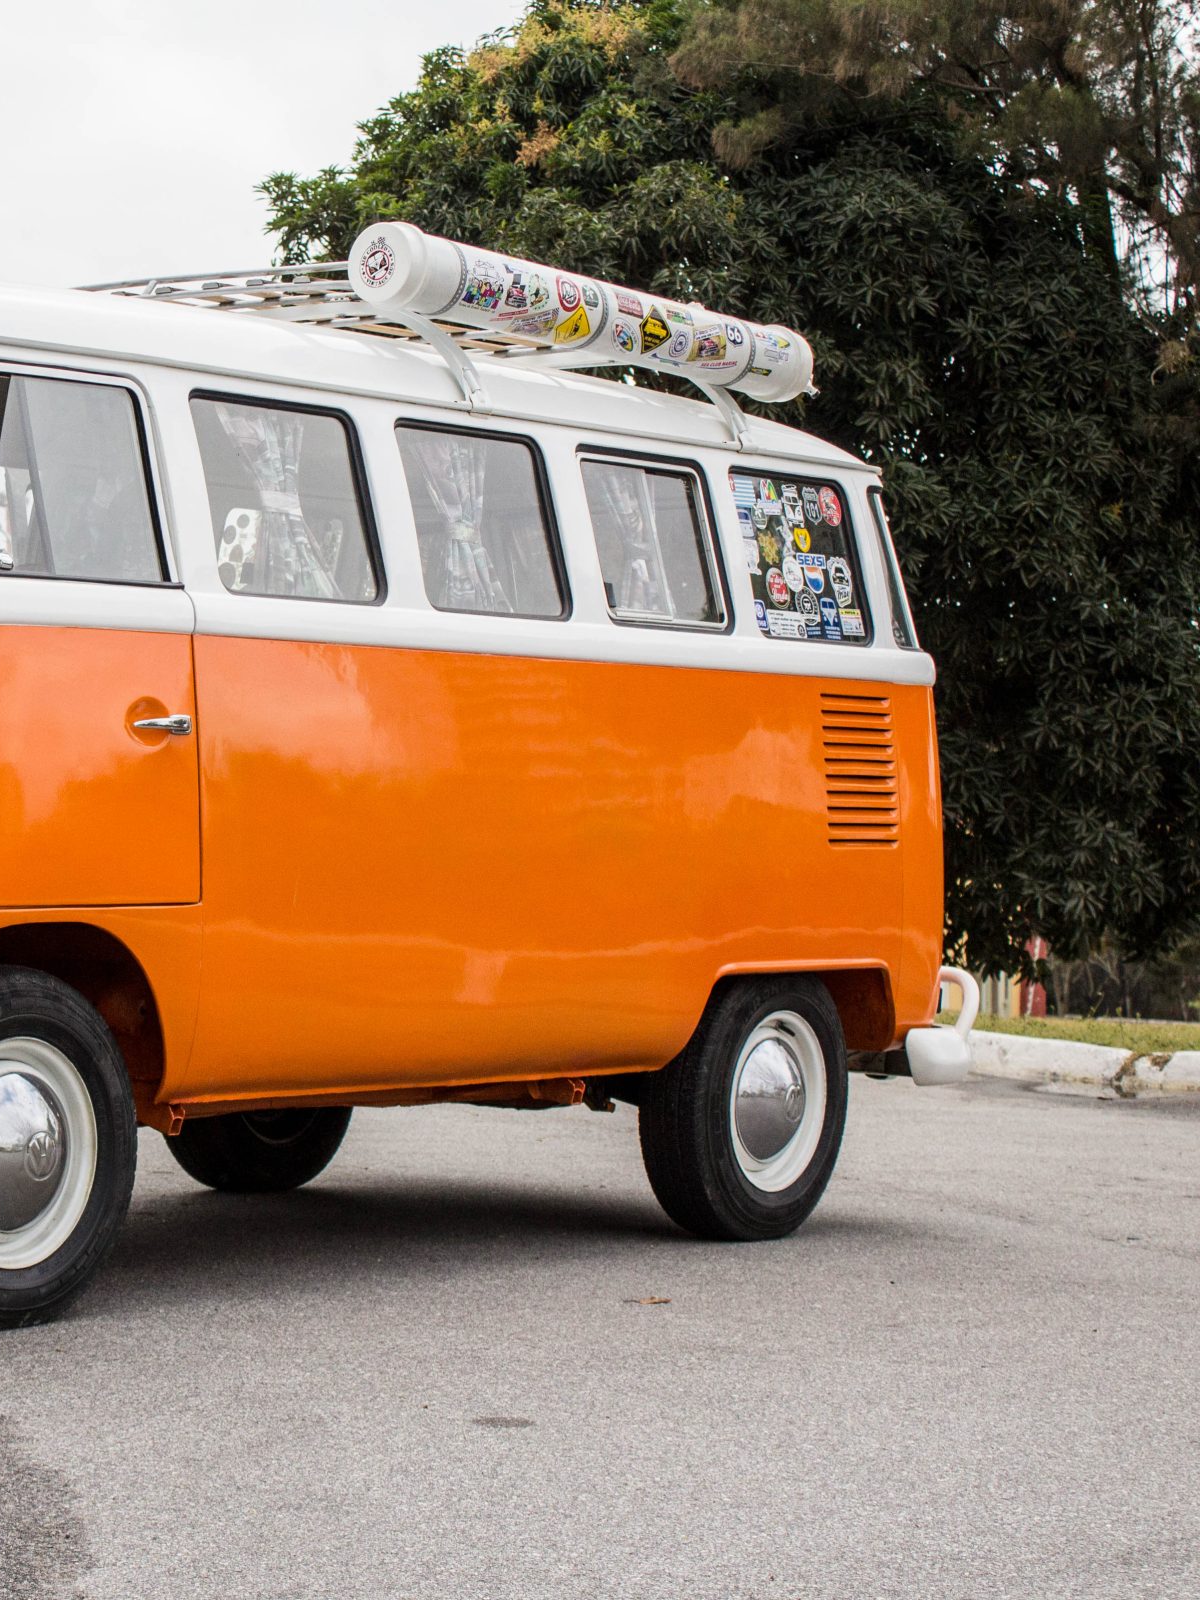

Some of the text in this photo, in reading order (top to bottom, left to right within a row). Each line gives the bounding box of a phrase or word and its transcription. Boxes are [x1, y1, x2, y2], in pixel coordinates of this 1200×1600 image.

[727, 325, 742, 344] 66
[806, 502, 820, 519] 101
[797, 554, 825, 568] SEXSI
